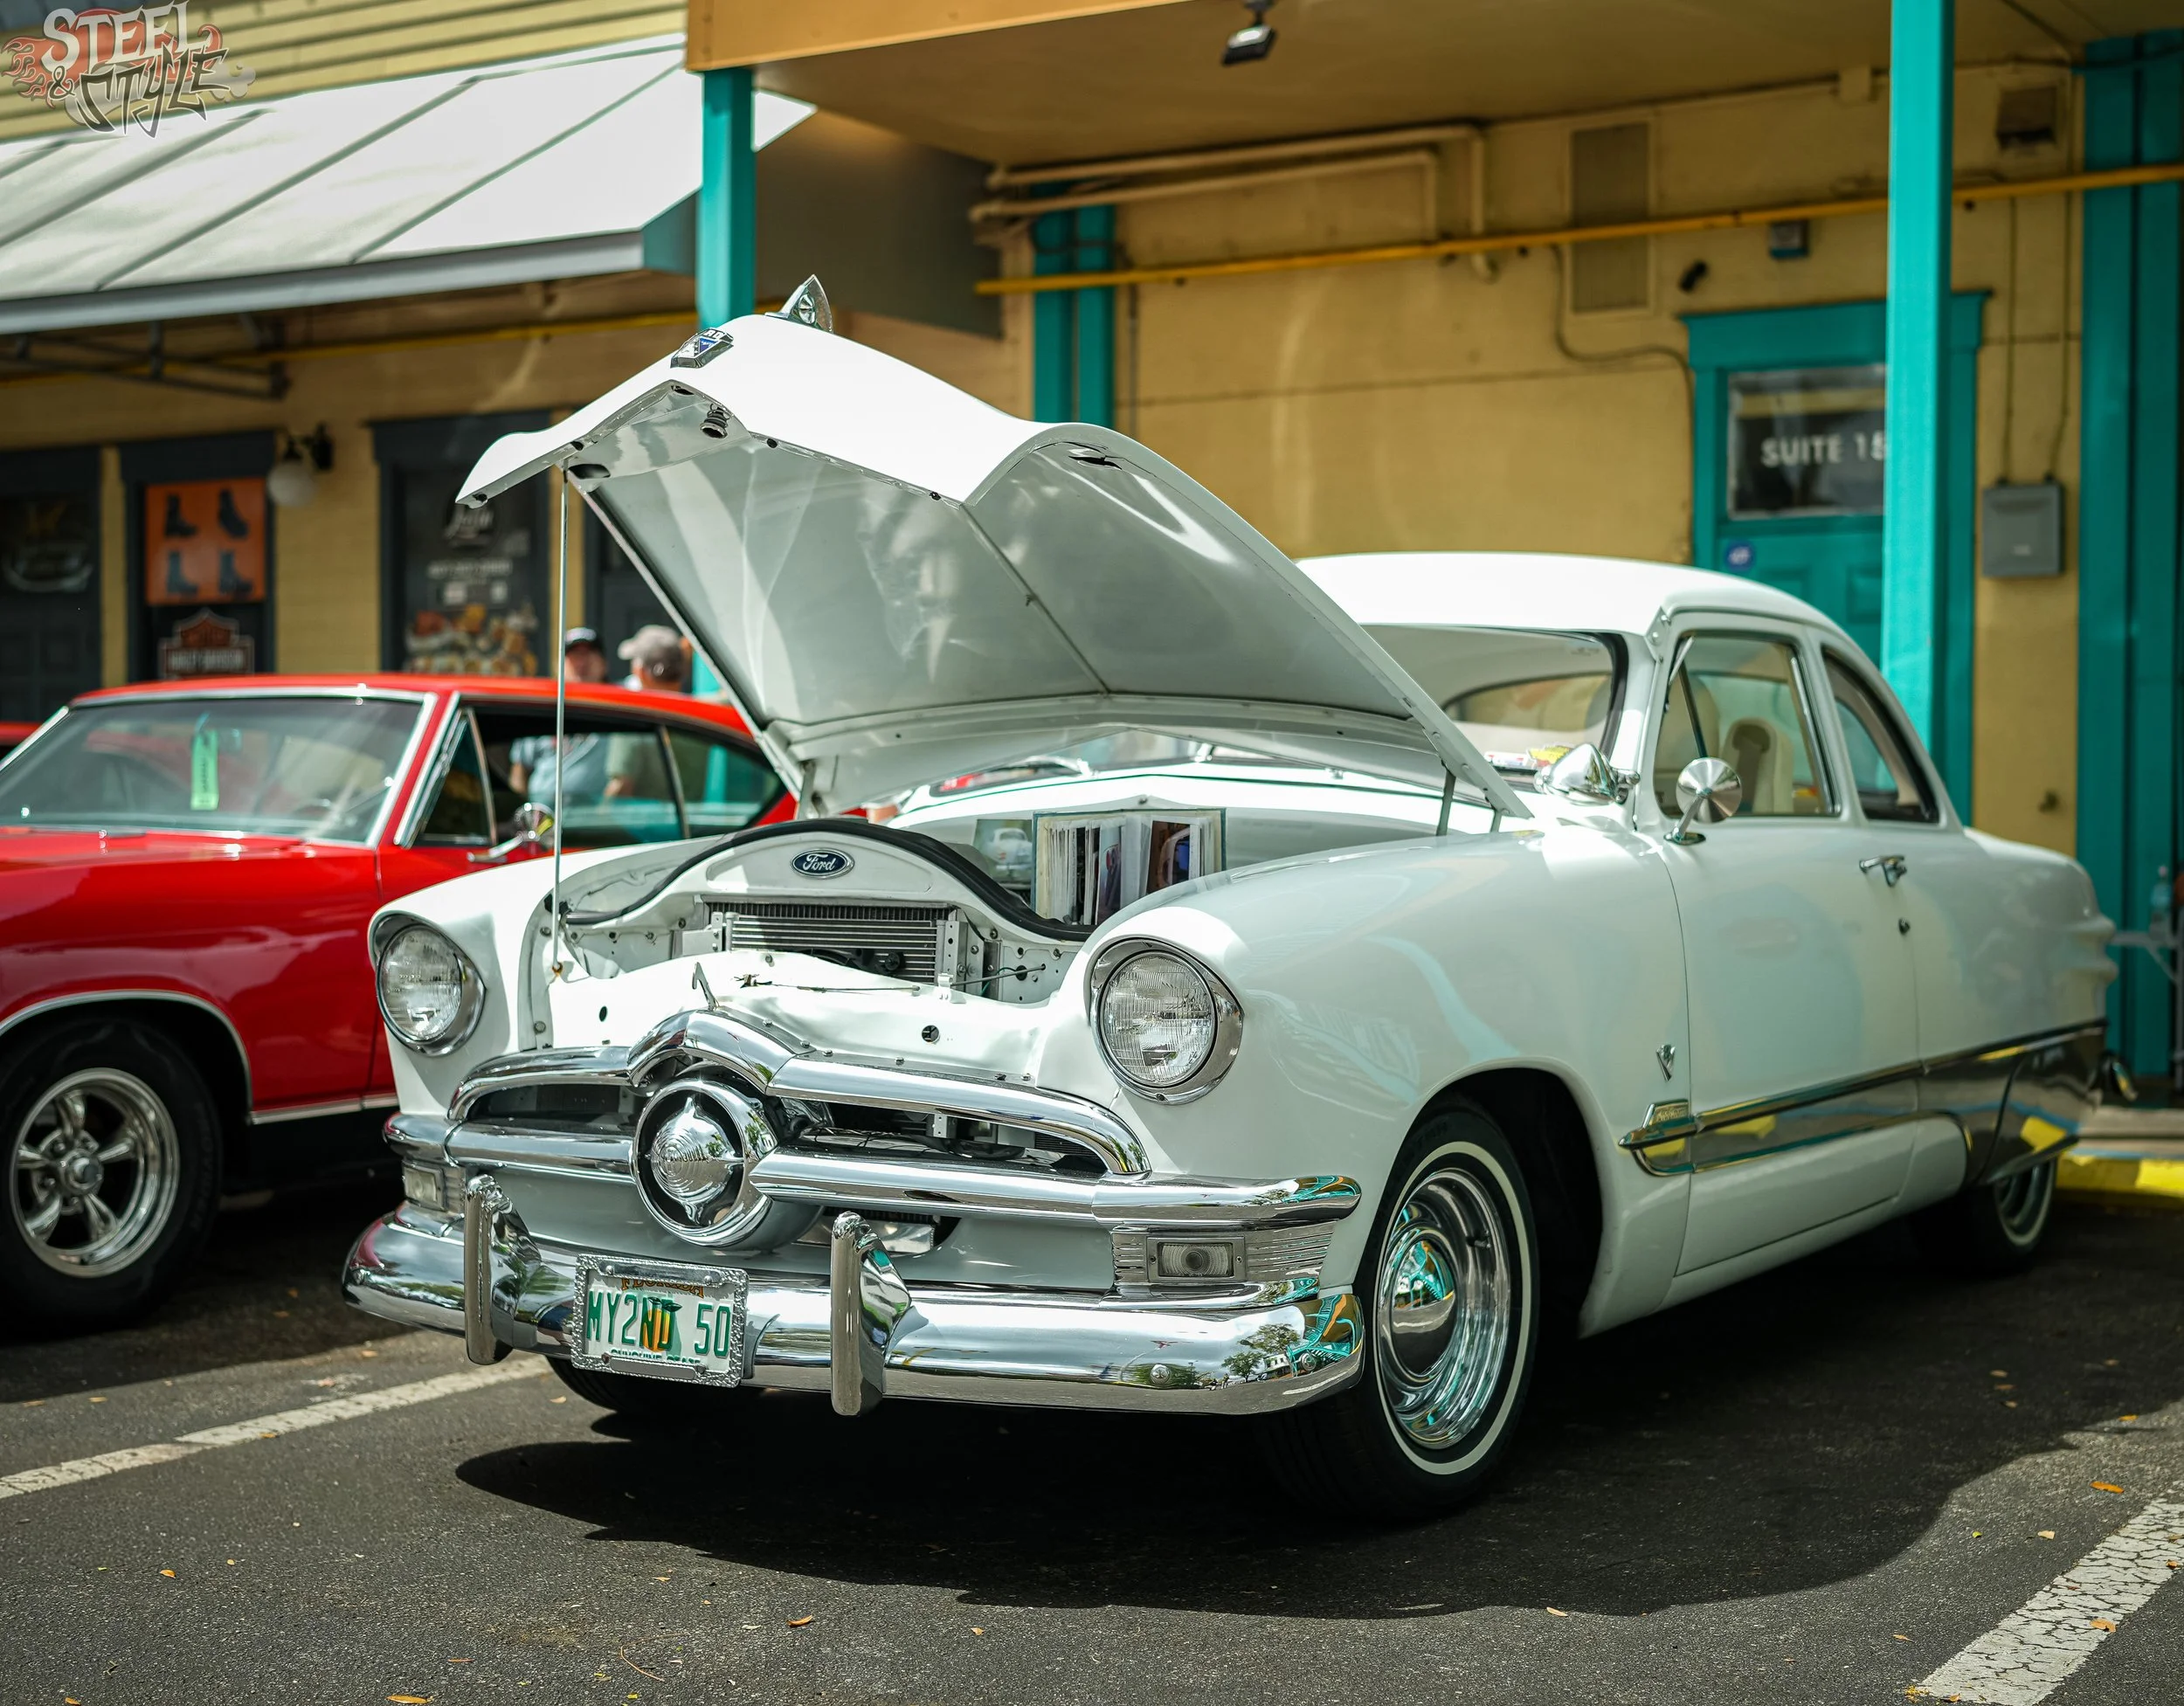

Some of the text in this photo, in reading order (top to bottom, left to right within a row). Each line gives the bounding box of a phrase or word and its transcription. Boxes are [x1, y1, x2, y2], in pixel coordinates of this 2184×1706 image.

[1760, 434, 1842, 467] SUITE
[802, 853, 837, 871] Ford
[694, 1302, 732, 1357] 50
